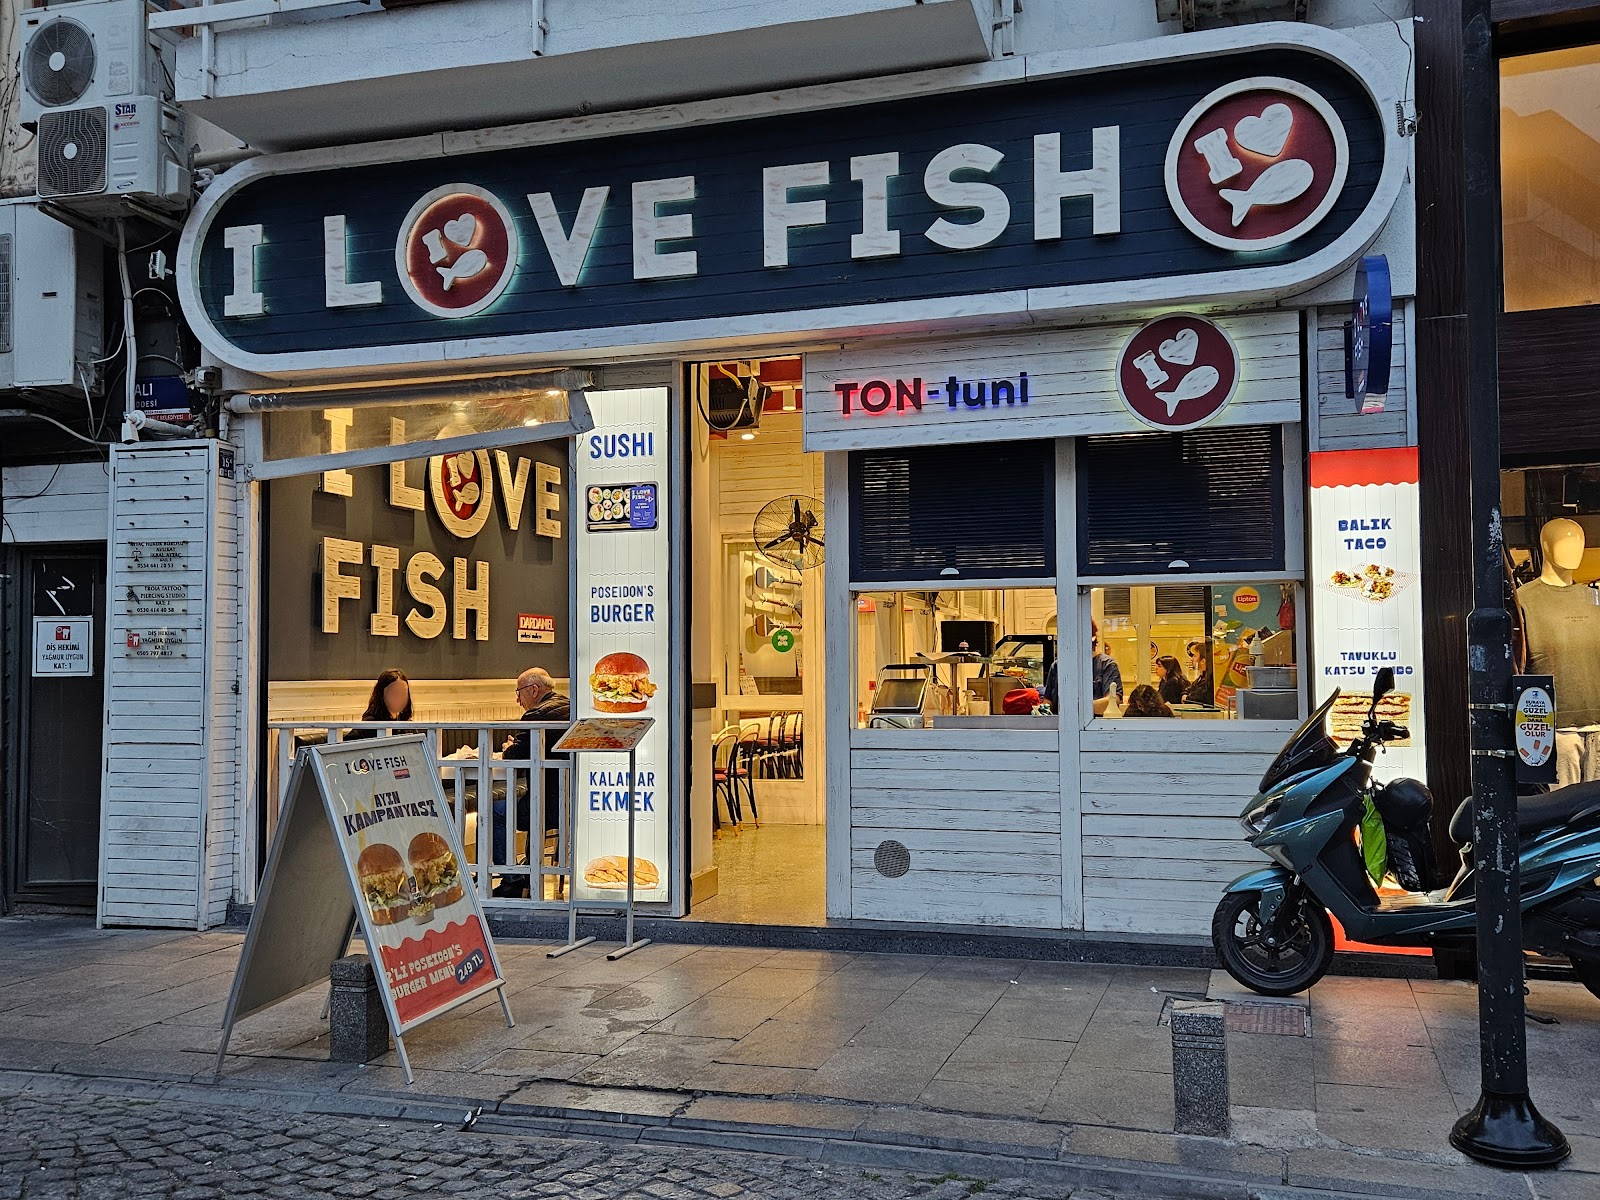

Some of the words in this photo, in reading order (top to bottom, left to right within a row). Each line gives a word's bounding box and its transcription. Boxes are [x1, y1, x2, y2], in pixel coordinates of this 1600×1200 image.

[115, 103, 136, 116] STAR
[223, 223, 265, 317] I
[323, 175, 698, 319] LOVE
[762, 125, 1121, 268] FISH
[135, 383, 153, 396] ALI
[322, 407, 354, 498] I
[590, 432, 653, 459] SUSHI
[1338, 517, 1392, 532] BALIK
[1343, 537, 1387, 550] TACO
[321, 536, 490, 641] FISH
[591, 584, 654, 599] POSEIDON'S
[1237, 595, 1257, 603] Lipton
[591, 603, 655, 623] BURGER
[520, 616, 555, 631] DARDANEL
[46, 642, 57, 652] DİŞ
[57, 641, 80, 651] HEKİMİ
[42, 652, 65, 661] YAĞMUR
[65, 653, 84, 661] UYGUN
[1340, 651, 1397, 661] TAVUKLU
[1325, 666, 1366, 675] KATSU
[1371, 665, 1413, 675] SDO
[383, 755, 408, 769] FISH
[373, 790, 401, 808] AYIN
[590, 790, 655, 812] EKMEK
[343, 799, 439, 837] KAMPANYASI
[408, 943, 463, 976] POSEIDON'S
[457, 961, 474, 982] 249
[471, 953, 484, 968] TL
[391, 976, 428, 1002] BURGER
[428, 960, 456, 986] MENÜ
